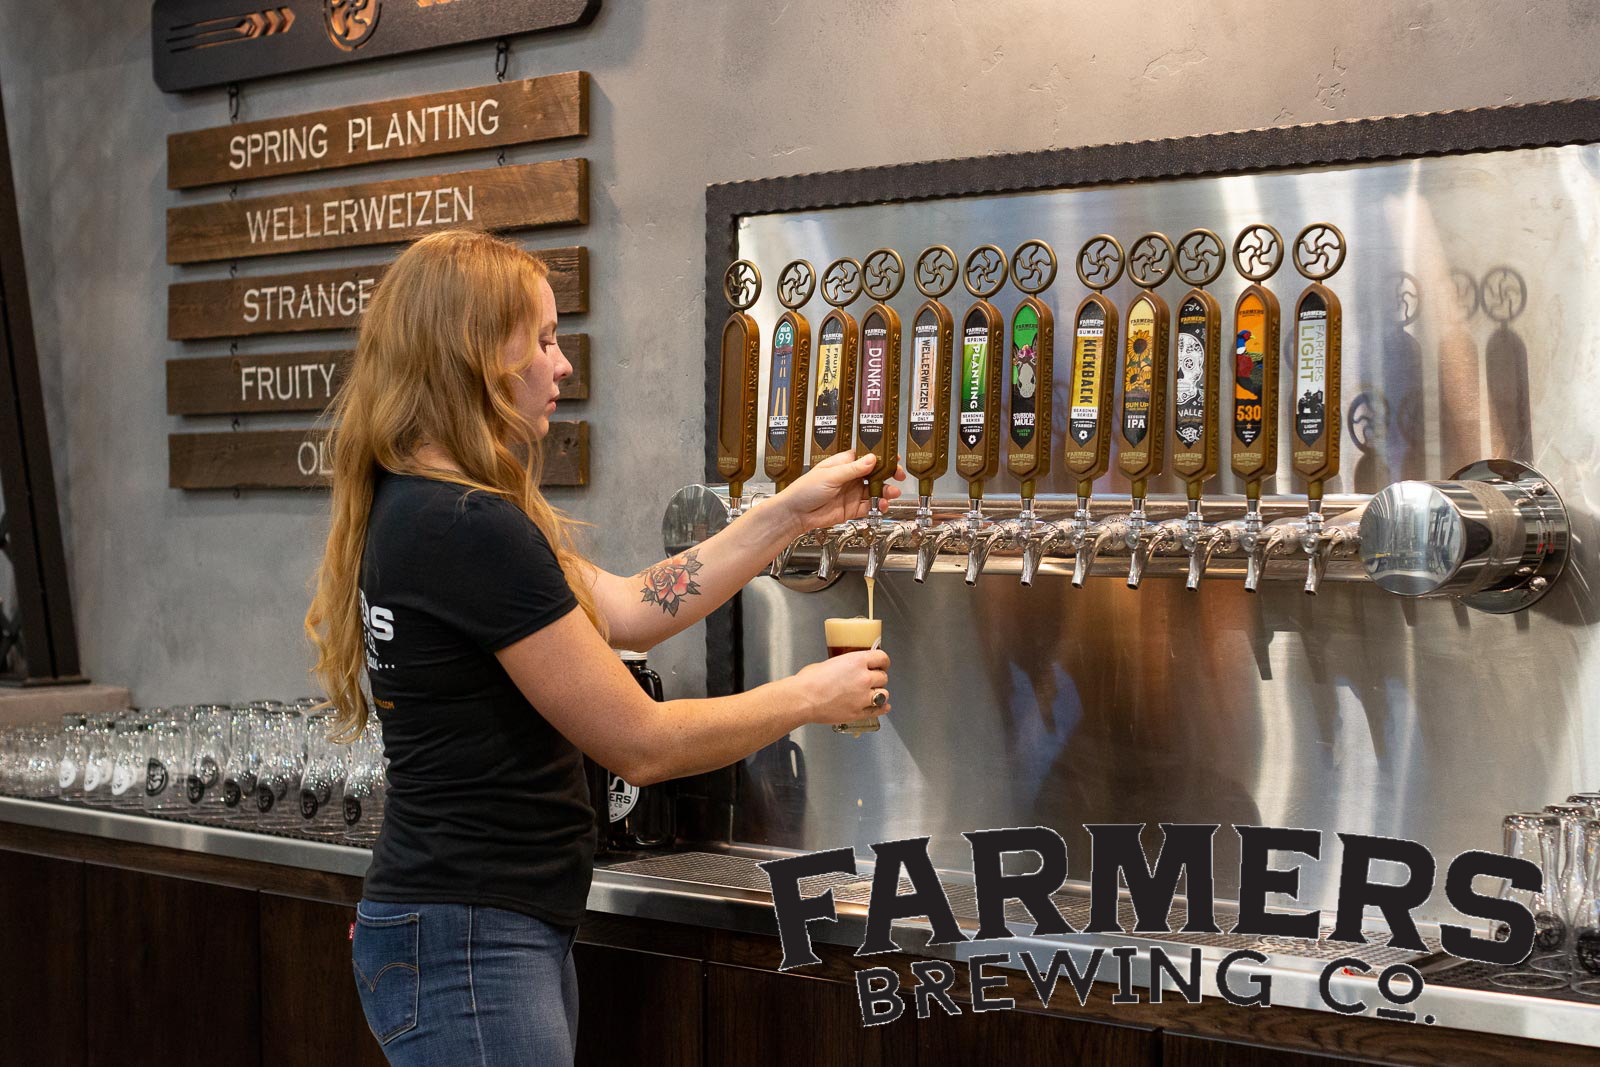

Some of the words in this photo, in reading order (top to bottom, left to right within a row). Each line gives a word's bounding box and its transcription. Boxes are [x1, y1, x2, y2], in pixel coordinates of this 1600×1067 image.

[229, 123, 328, 170] SPRING
[348, 99, 499, 153] PLANTING
[246, 185, 474, 244] WELLERWEIZEN
[243, 278, 375, 322] STRANGE
[778, 332, 791, 344] 99
[916, 324, 938, 332] FARMERS
[1314, 324, 1325, 382] FARMERS
[866, 348, 882, 406] DUNKEL
[920, 339, 931, 410] WELLERWEIZEN
[970, 346, 980, 410] PLANTING
[1080, 340, 1097, 404] KICKBACK
[1300, 325, 1314, 382] LIGHT
[241, 363, 336, 401] FRUITY
[1014, 418, 1034, 426] MULE
[1127, 419, 1146, 428] IPA
[1178, 408, 1204, 418] VALLE
[1236, 404, 1262, 422] 530
